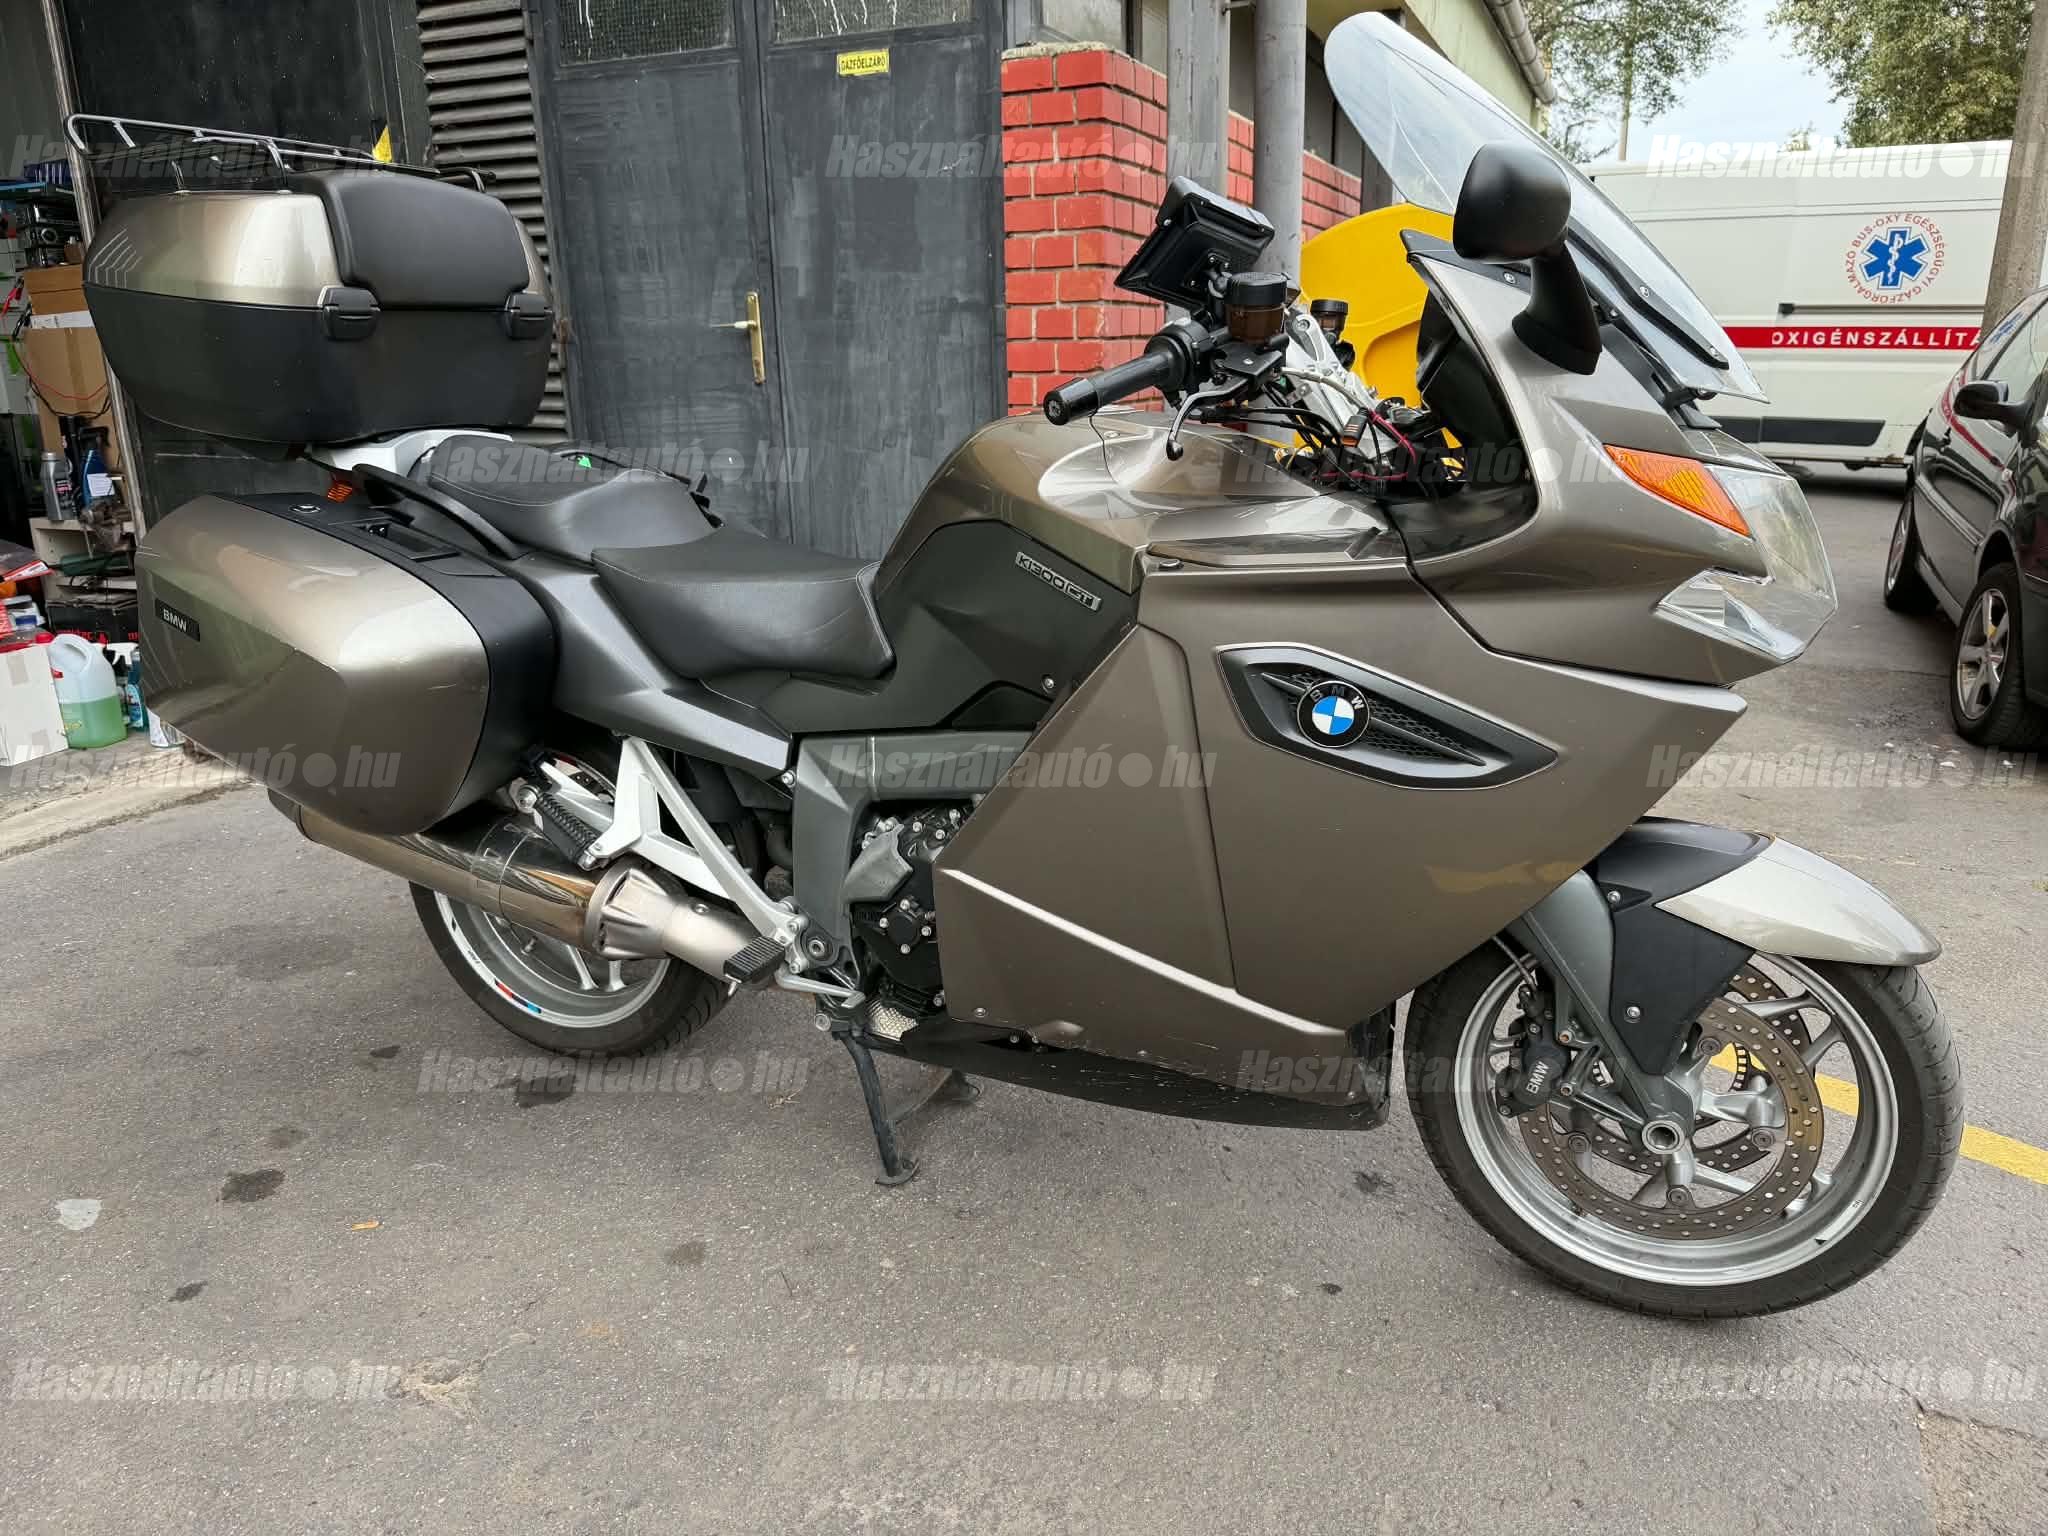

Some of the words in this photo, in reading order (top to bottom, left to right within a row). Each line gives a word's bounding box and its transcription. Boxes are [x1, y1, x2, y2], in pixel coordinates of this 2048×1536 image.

[163, 608, 187, 632] BMW
[1310, 684, 1365, 710] BMW
[1526, 1060, 1549, 1094] BMW
